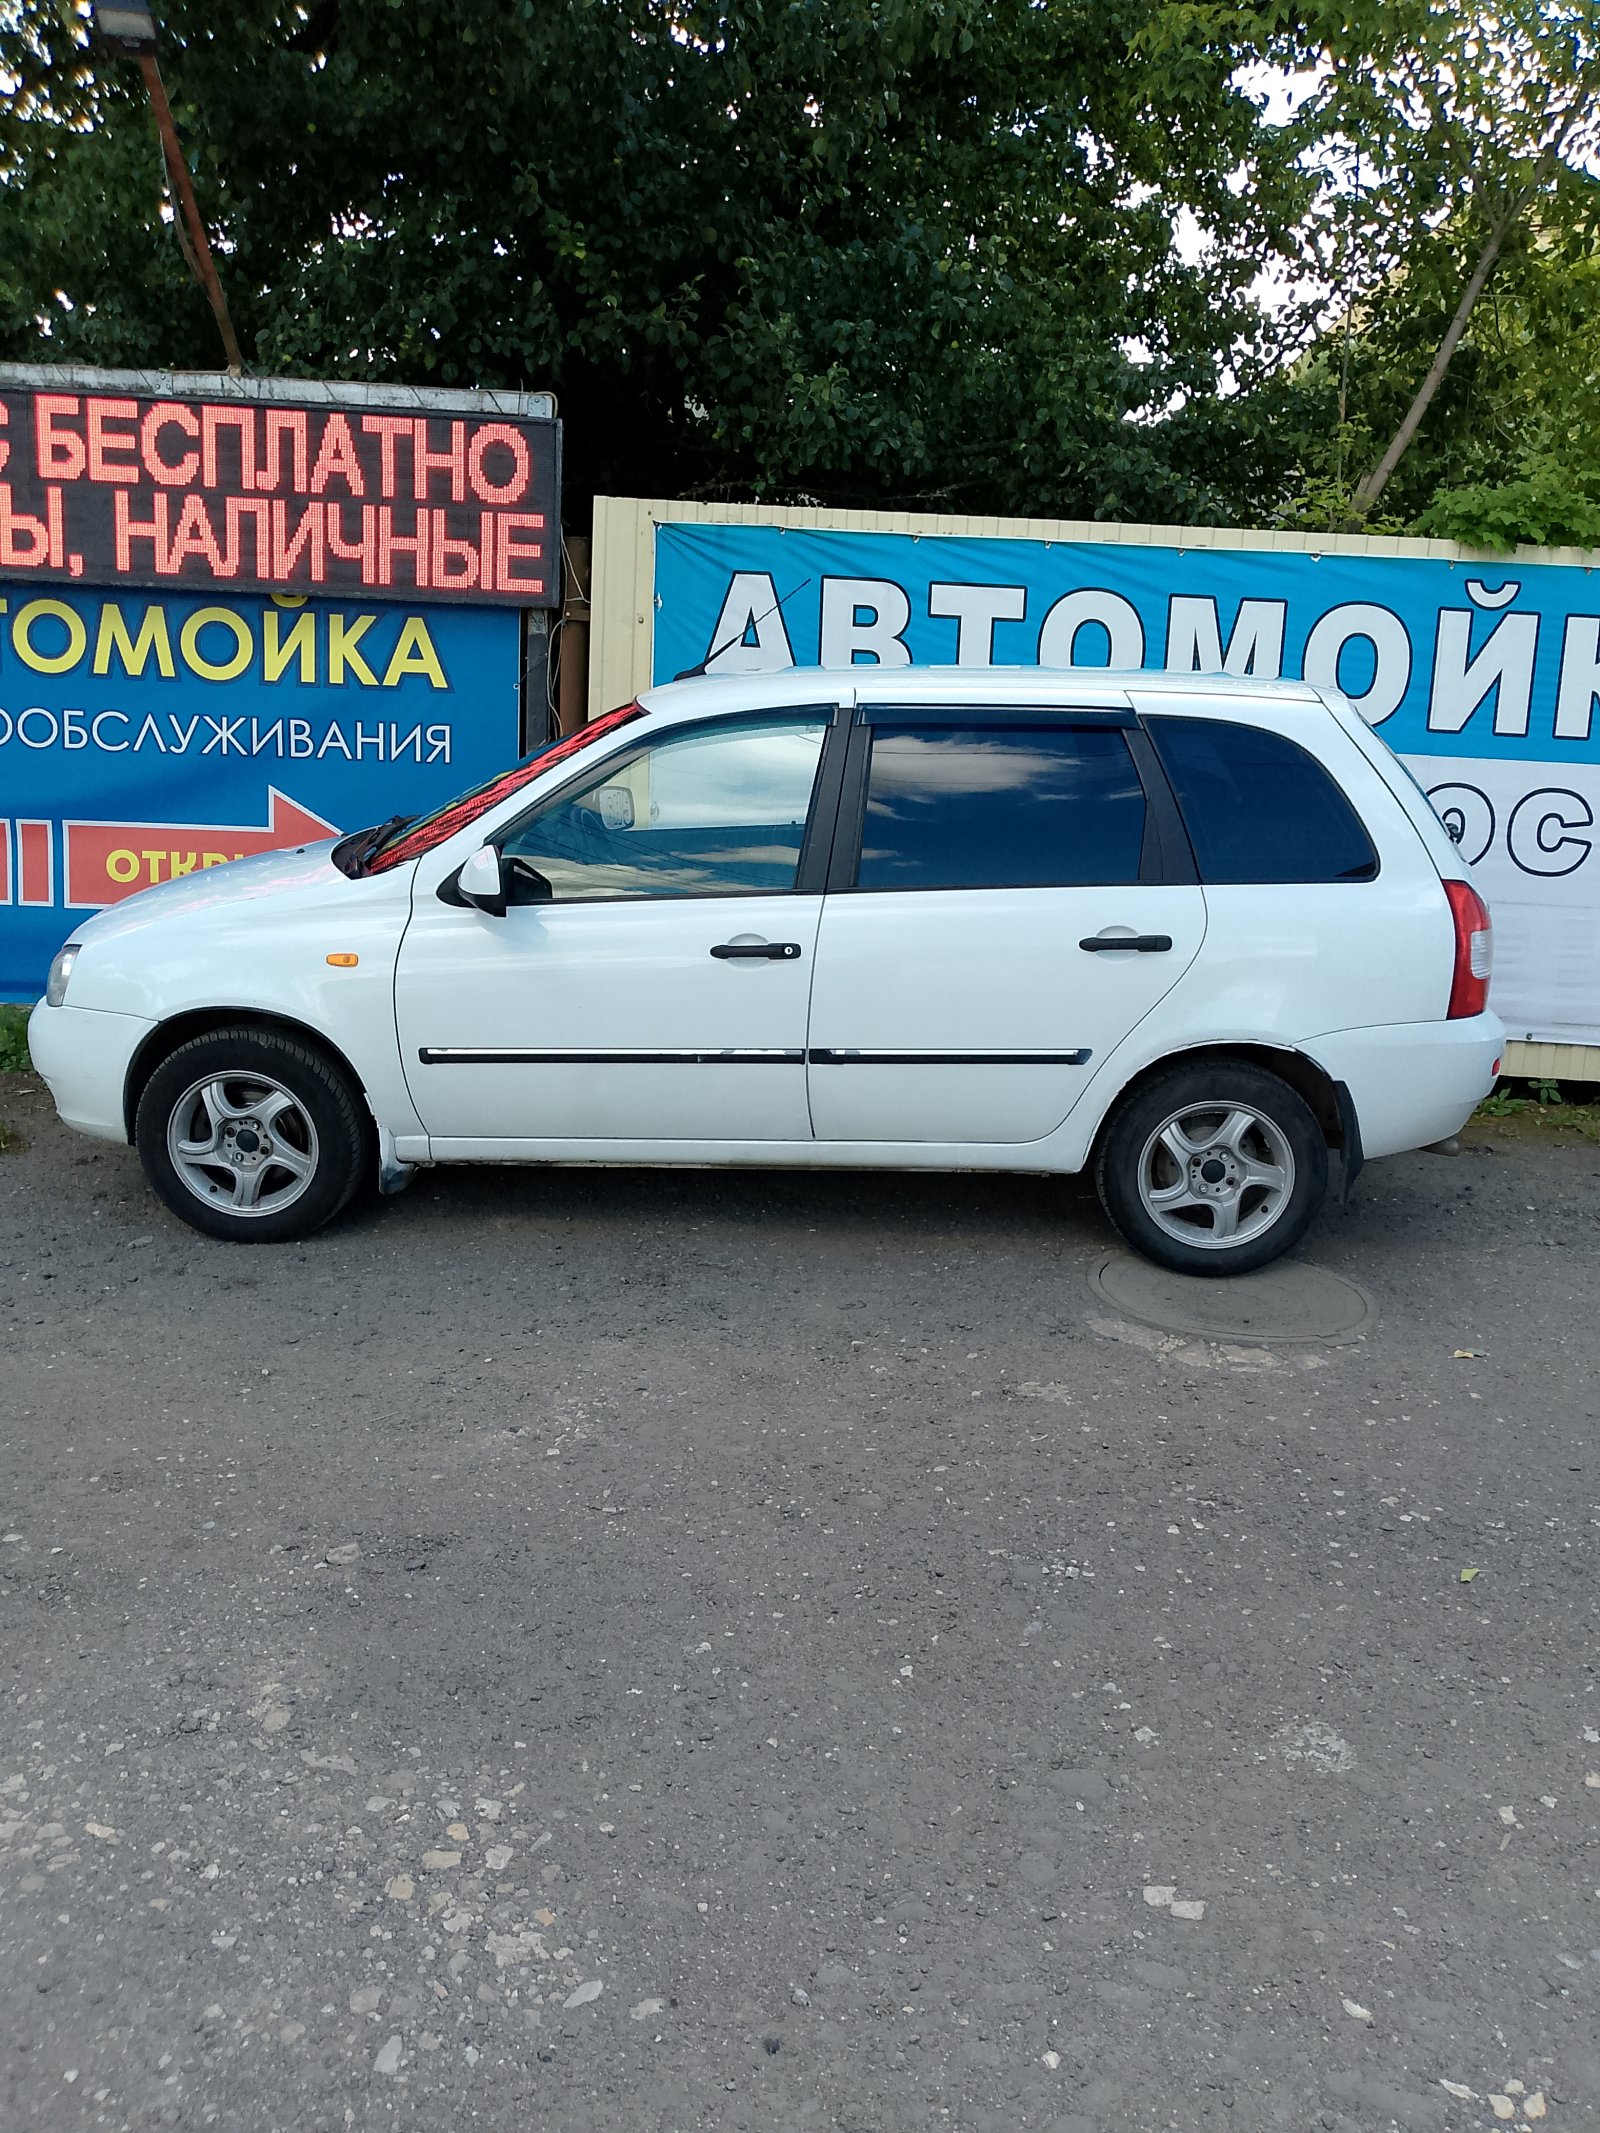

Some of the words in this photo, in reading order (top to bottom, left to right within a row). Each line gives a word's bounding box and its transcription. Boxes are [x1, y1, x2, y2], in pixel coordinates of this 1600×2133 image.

[35, 393, 531, 504] БЕСПЛАТНО
[113, 488, 546, 594] НАЛИЧНЫЕ
[0, 594, 448, 690] ОМОЙКА
